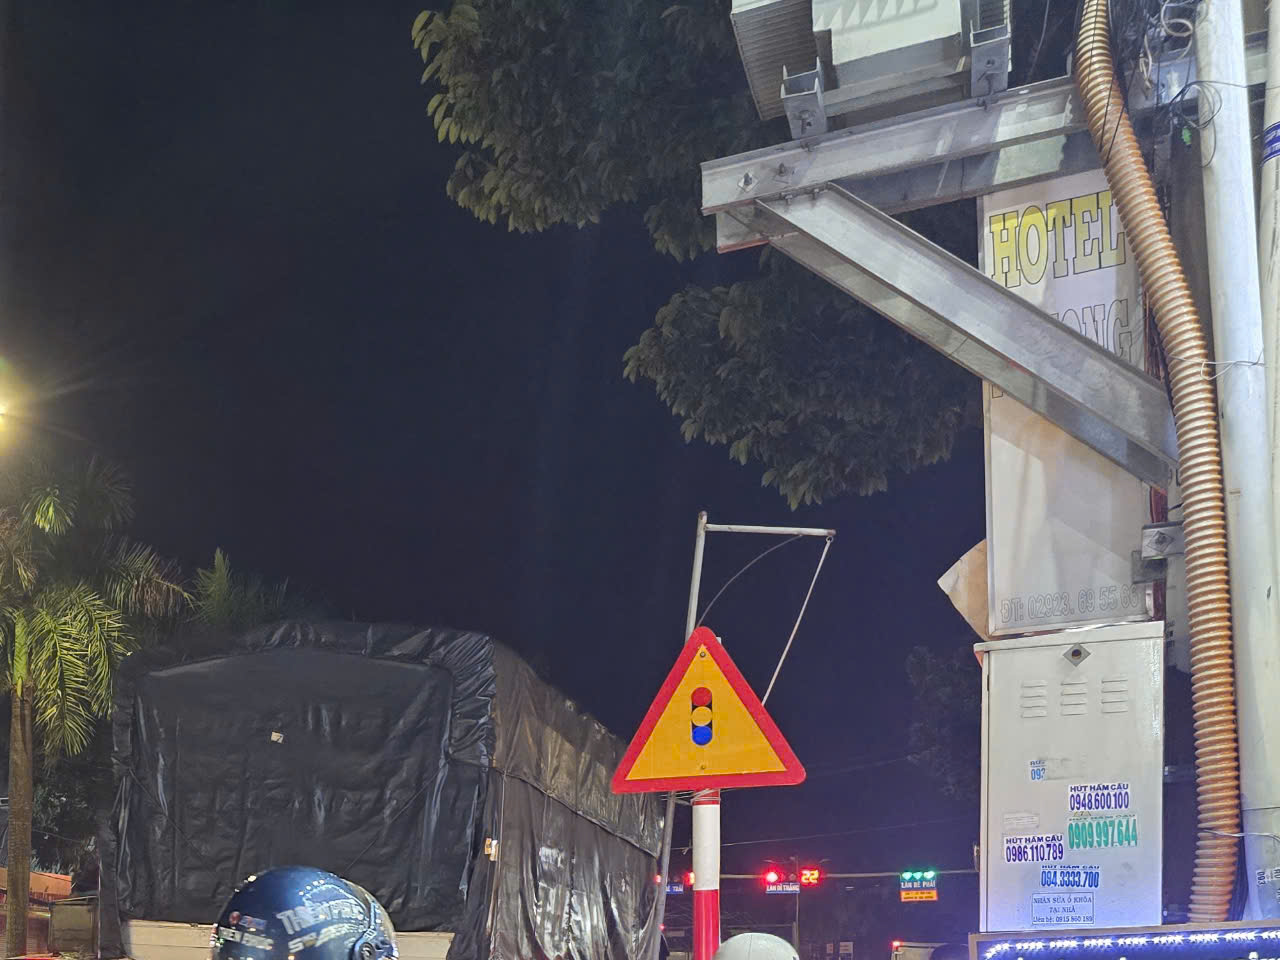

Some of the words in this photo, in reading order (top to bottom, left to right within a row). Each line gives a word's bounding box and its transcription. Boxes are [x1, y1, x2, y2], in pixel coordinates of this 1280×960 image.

[989, 191, 1126, 288] HOTEL
[1070, 791, 1129, 810] 0948.600.100
[1006, 844, 1064, 862] 0986.110.789
[801, 870, 819, 883] 22
[1041, 871, 1100, 888] 094.3333.700
